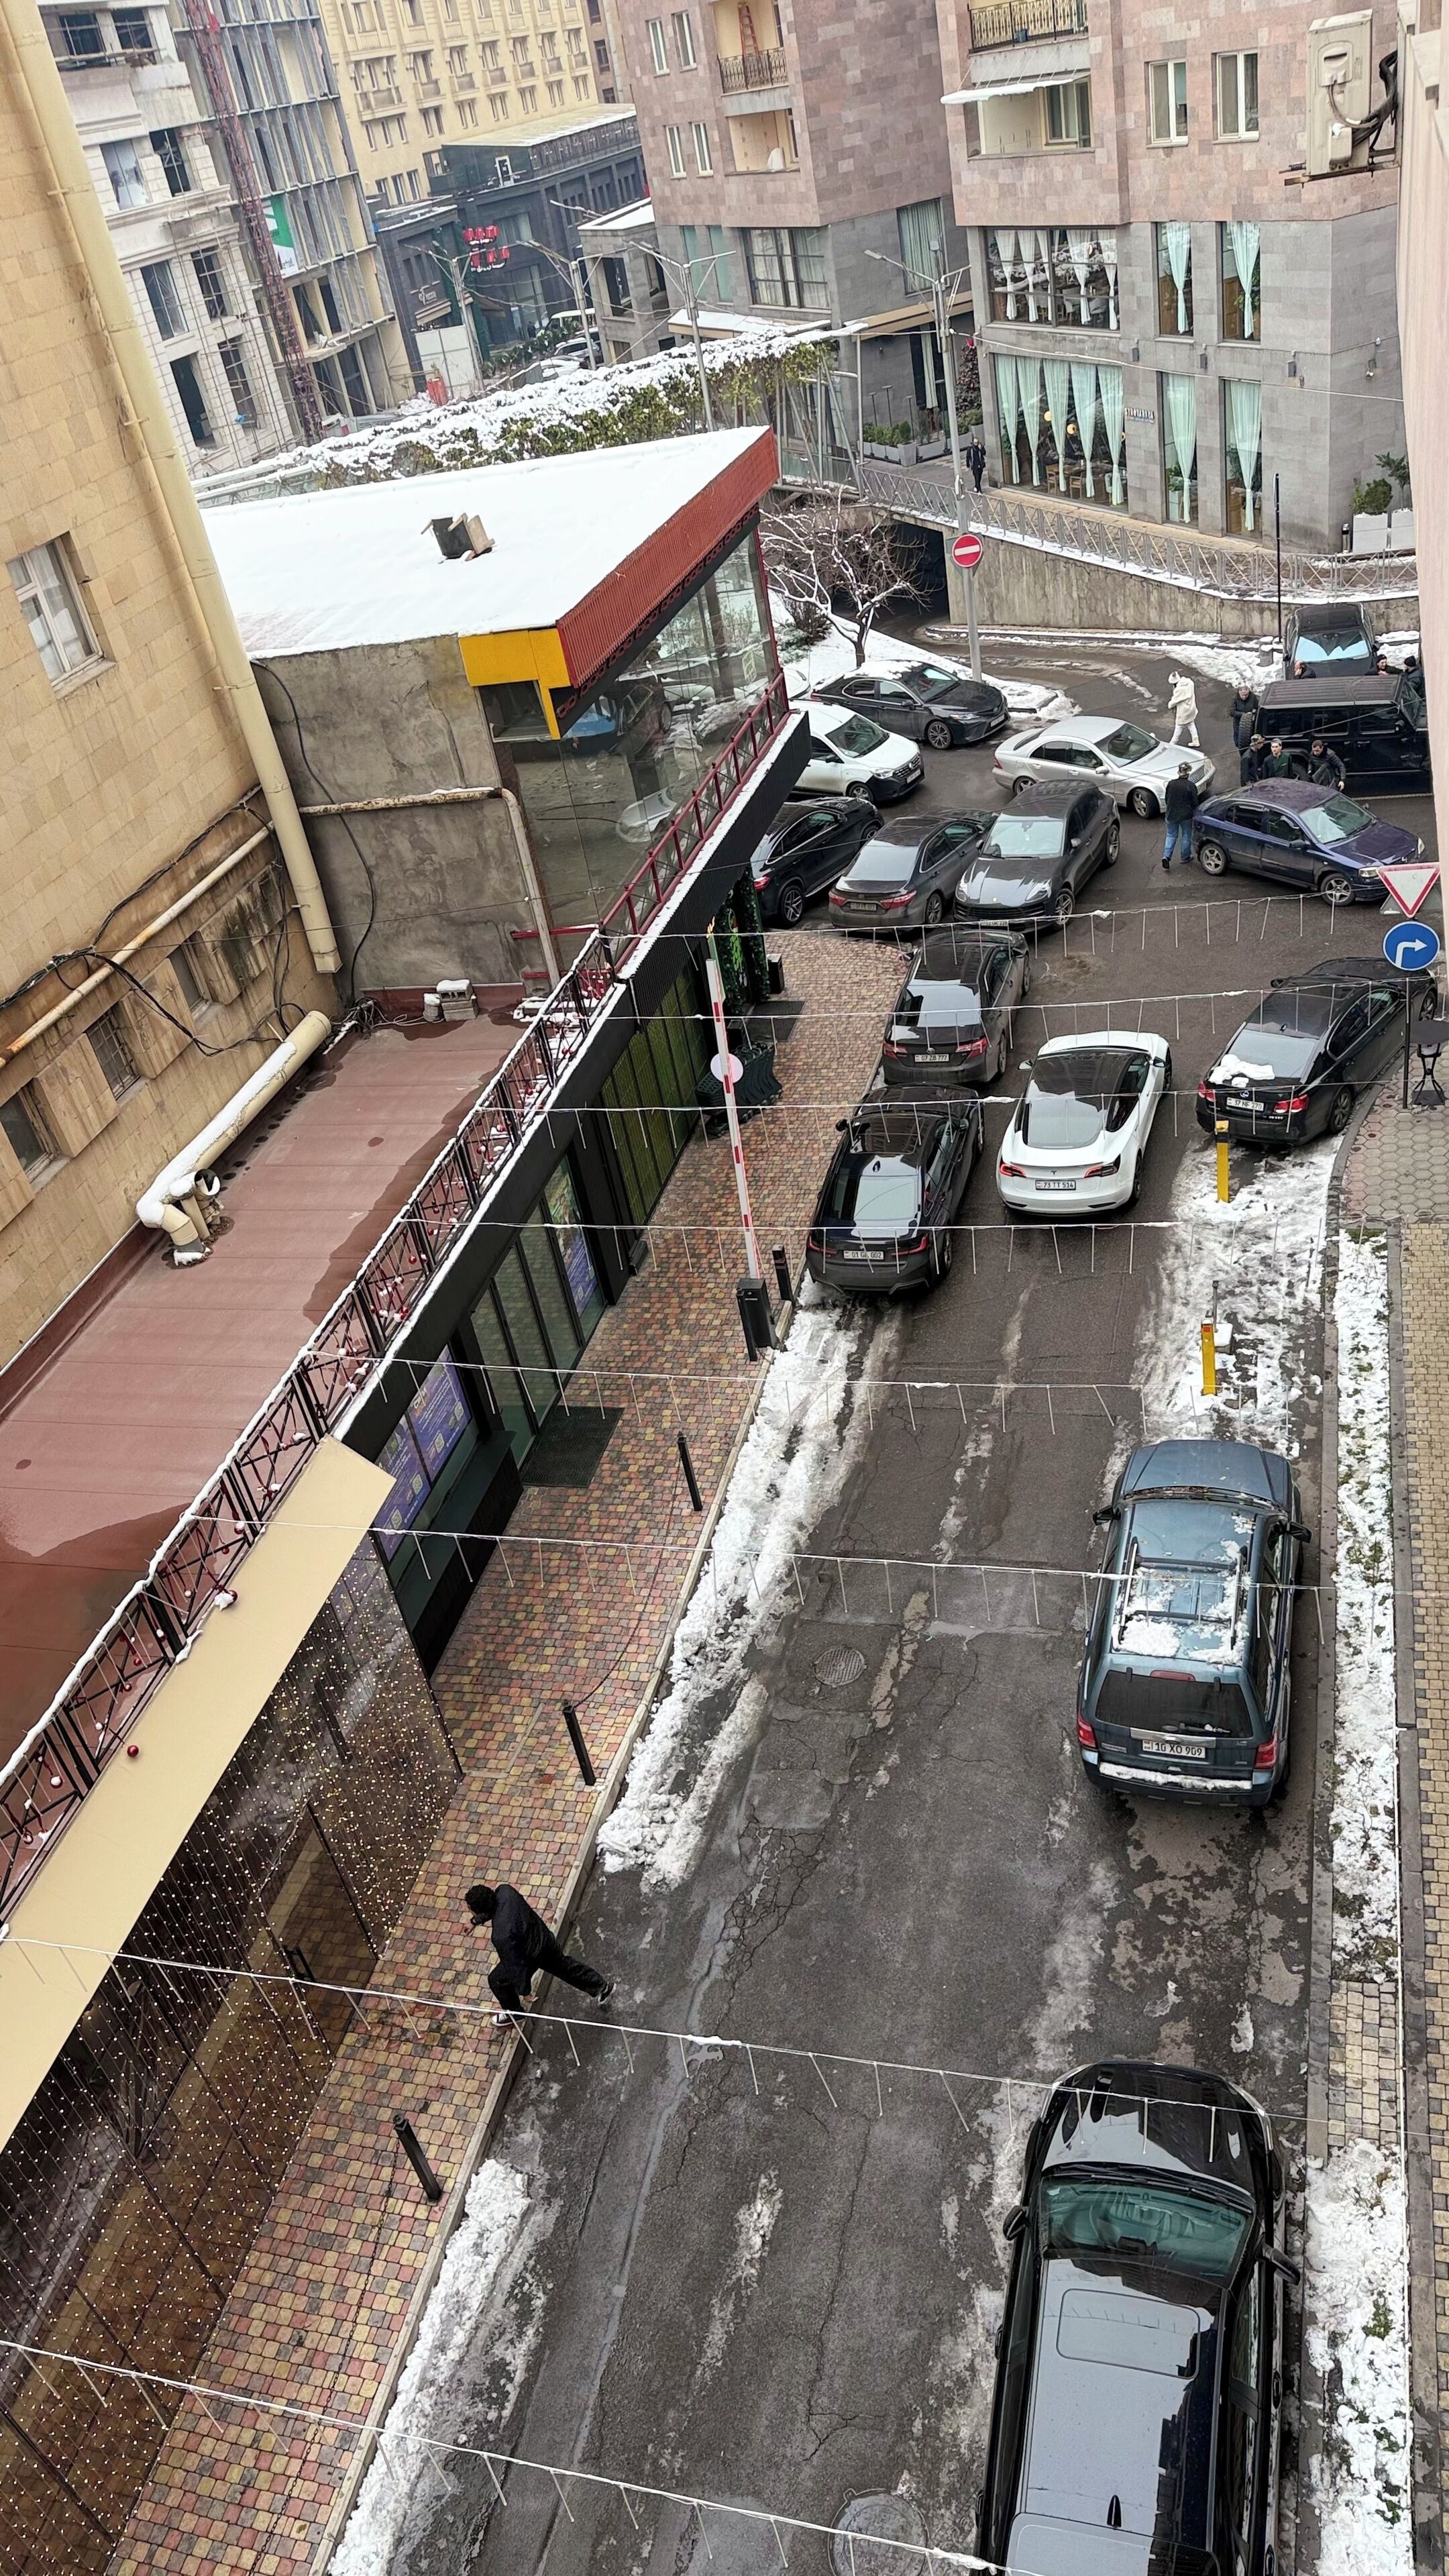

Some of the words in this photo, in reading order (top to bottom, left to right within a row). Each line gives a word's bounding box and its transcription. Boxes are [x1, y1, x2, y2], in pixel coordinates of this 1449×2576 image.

[1155, 1743, 1166, 1752] 10
[1169, 1744, 1182, 1754] XO
[1185, 1746, 1202, 1756] 909
